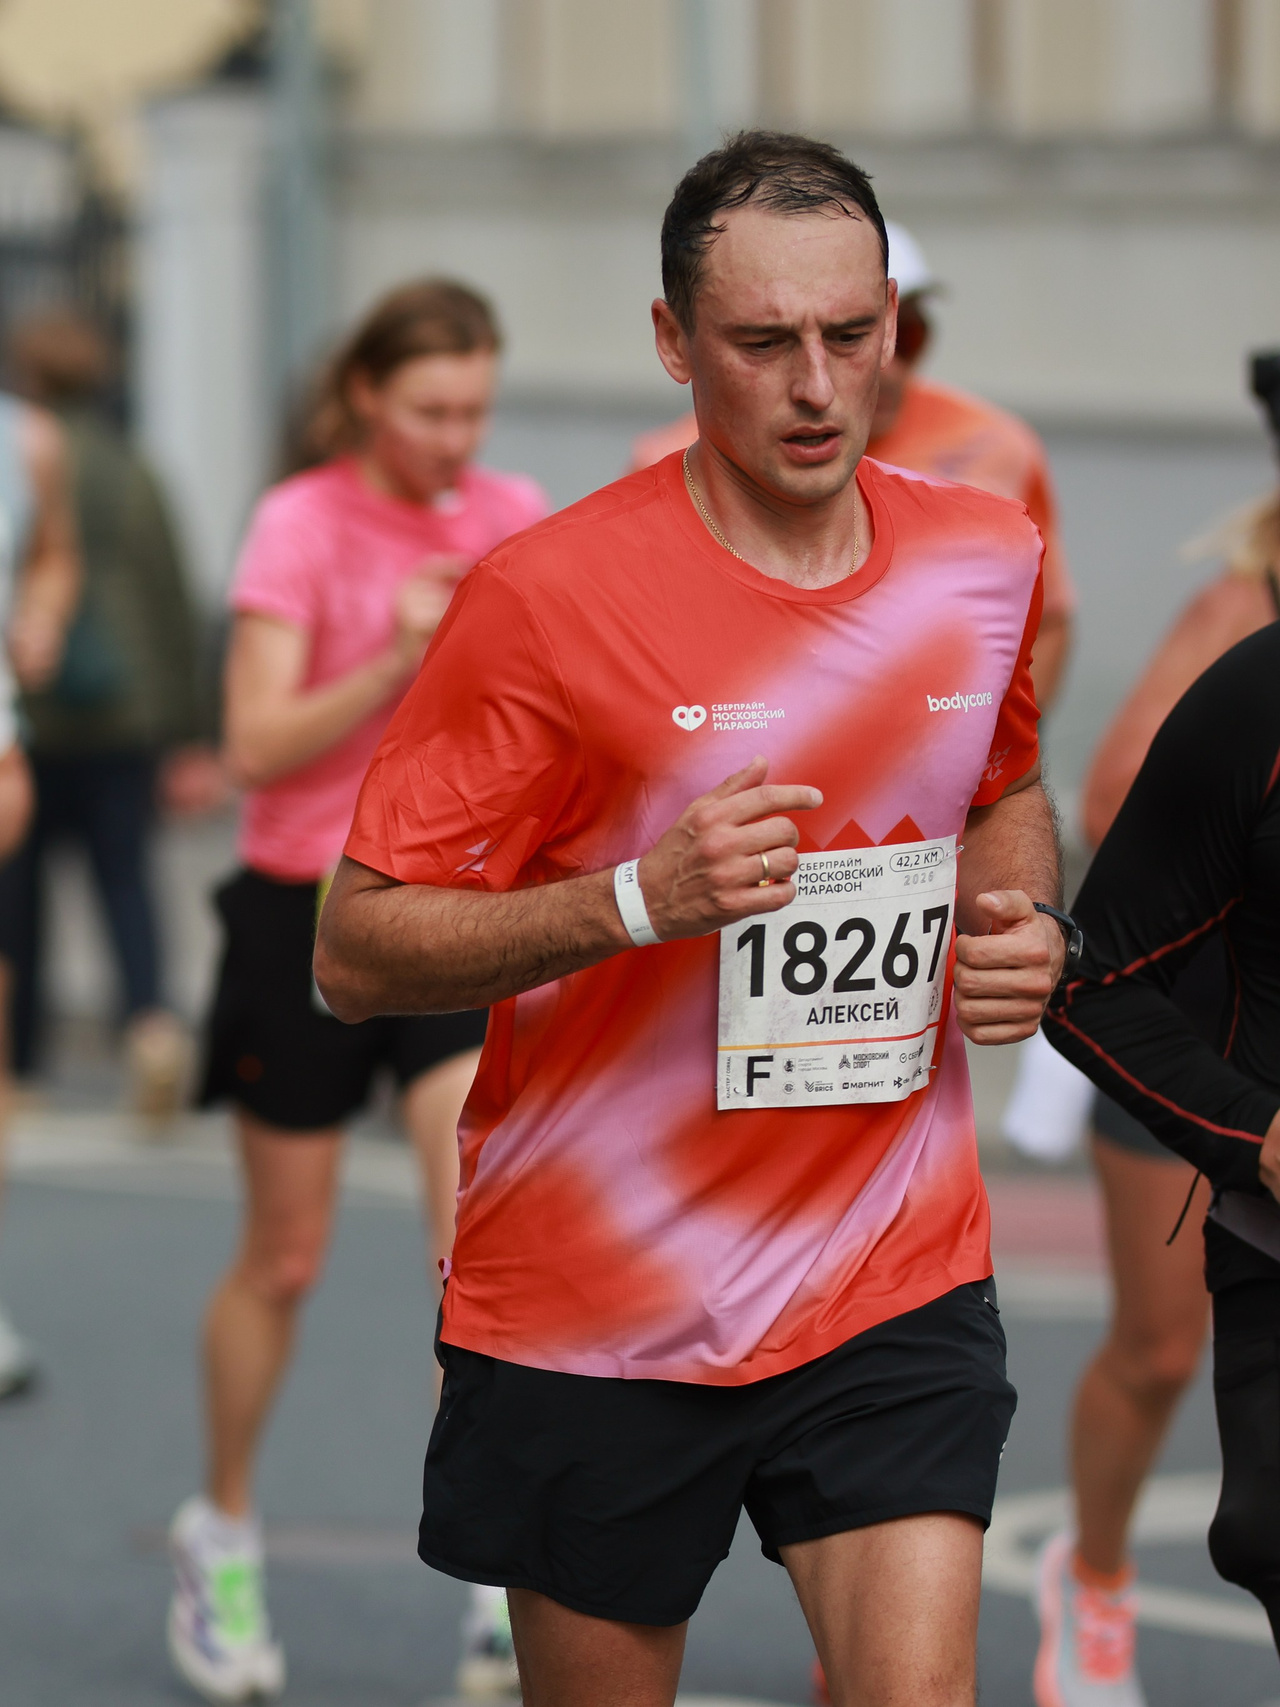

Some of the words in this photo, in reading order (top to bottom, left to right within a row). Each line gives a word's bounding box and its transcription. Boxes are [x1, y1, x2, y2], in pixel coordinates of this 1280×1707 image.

[711, 702, 766, 712] СБЕРПРАЙМ
[926, 690, 993, 713] bodycore
[712, 708, 785, 722] МОСКОВСКИЙ
[713, 720, 768, 731] МАРАФОН
[798, 857, 863, 872] СБЕРПРАЙМ
[896, 854, 921, 869] 42,2
[798, 867, 883, 884] МОСКОВСКИЙ
[903, 870, 935, 887] 2026
[797, 881, 863, 896] МАРАФОН
[736, 903, 950, 998] 18267
[806, 997, 899, 1026] АЛЕКСЕЙ
[853, 1051, 889, 1061] МОСКОВСКИЙ
[853, 1061, 870, 1069] СПОРТ
[746, 1055, 774, 1097] F
